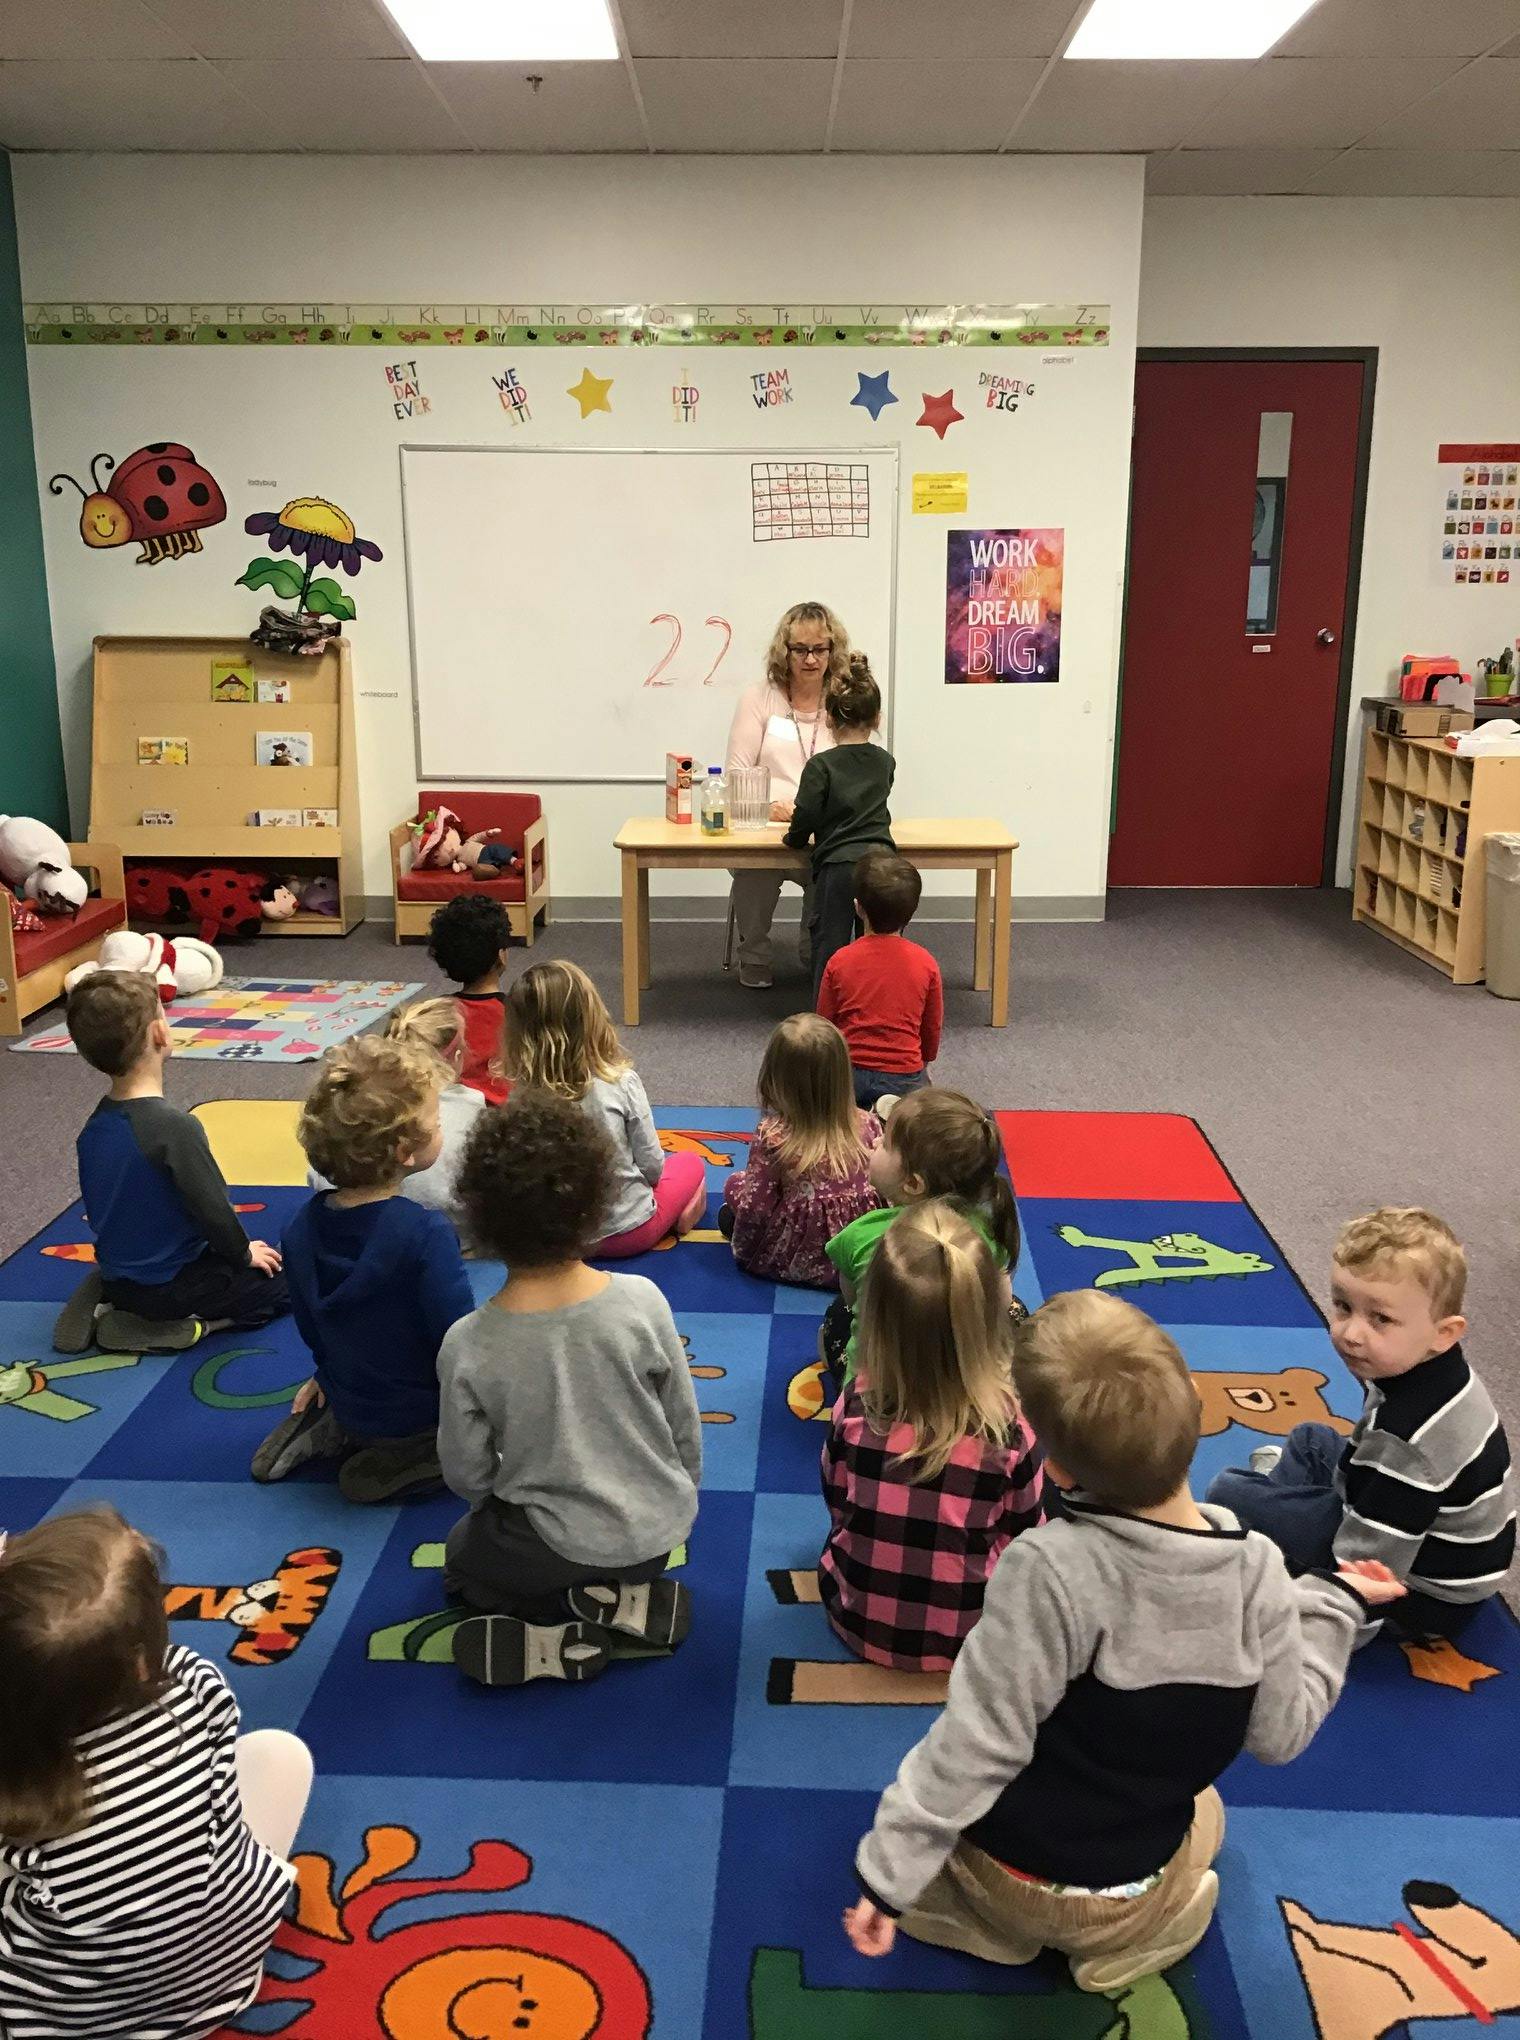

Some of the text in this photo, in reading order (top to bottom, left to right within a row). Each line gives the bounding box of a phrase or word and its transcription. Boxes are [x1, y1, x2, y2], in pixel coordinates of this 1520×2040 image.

[36, 306, 61, 324] Aa
[72, 306, 95, 324] Bb
[108, 306, 132, 324] Cc
[145, 306, 169, 324] Dd
[190, 306, 211, 324] Ee
[226, 306, 246, 324] Ff
[301, 306, 325, 324] Hh
[419, 307, 442, 325] Kk
[498, 308, 530, 325] Mm
[540, 308, 566, 325] Nn
[577, 308, 602, 325] Oo
[697, 308, 716, 325] Rr
[736, 308, 753, 325] Ss
[773, 308, 790, 325] Tt
[812, 308, 833, 325] Uu
[860, 308, 879, 325] Vv
[1075, 308, 1096, 325] Zz
[385, 361, 417, 384] BEST
[492, 368, 520, 391] WE
[750, 368, 790, 391] TEAM
[978, 372, 1035, 396] DREAMING
[393, 380, 421, 400] DAY
[499, 386, 527, 410] DID
[672, 387, 699, 405] DID
[753, 388, 794, 409] WORK
[987, 389, 1018, 412] BIG
[394, 397, 432, 420] EVER
[673, 405, 696, 423] IT!
[970, 539, 1038, 567] WORK
[969, 569, 1040, 598] HARD.
[968, 601, 1040, 626] DREAM
[968, 626, 1045, 675] BIG.
